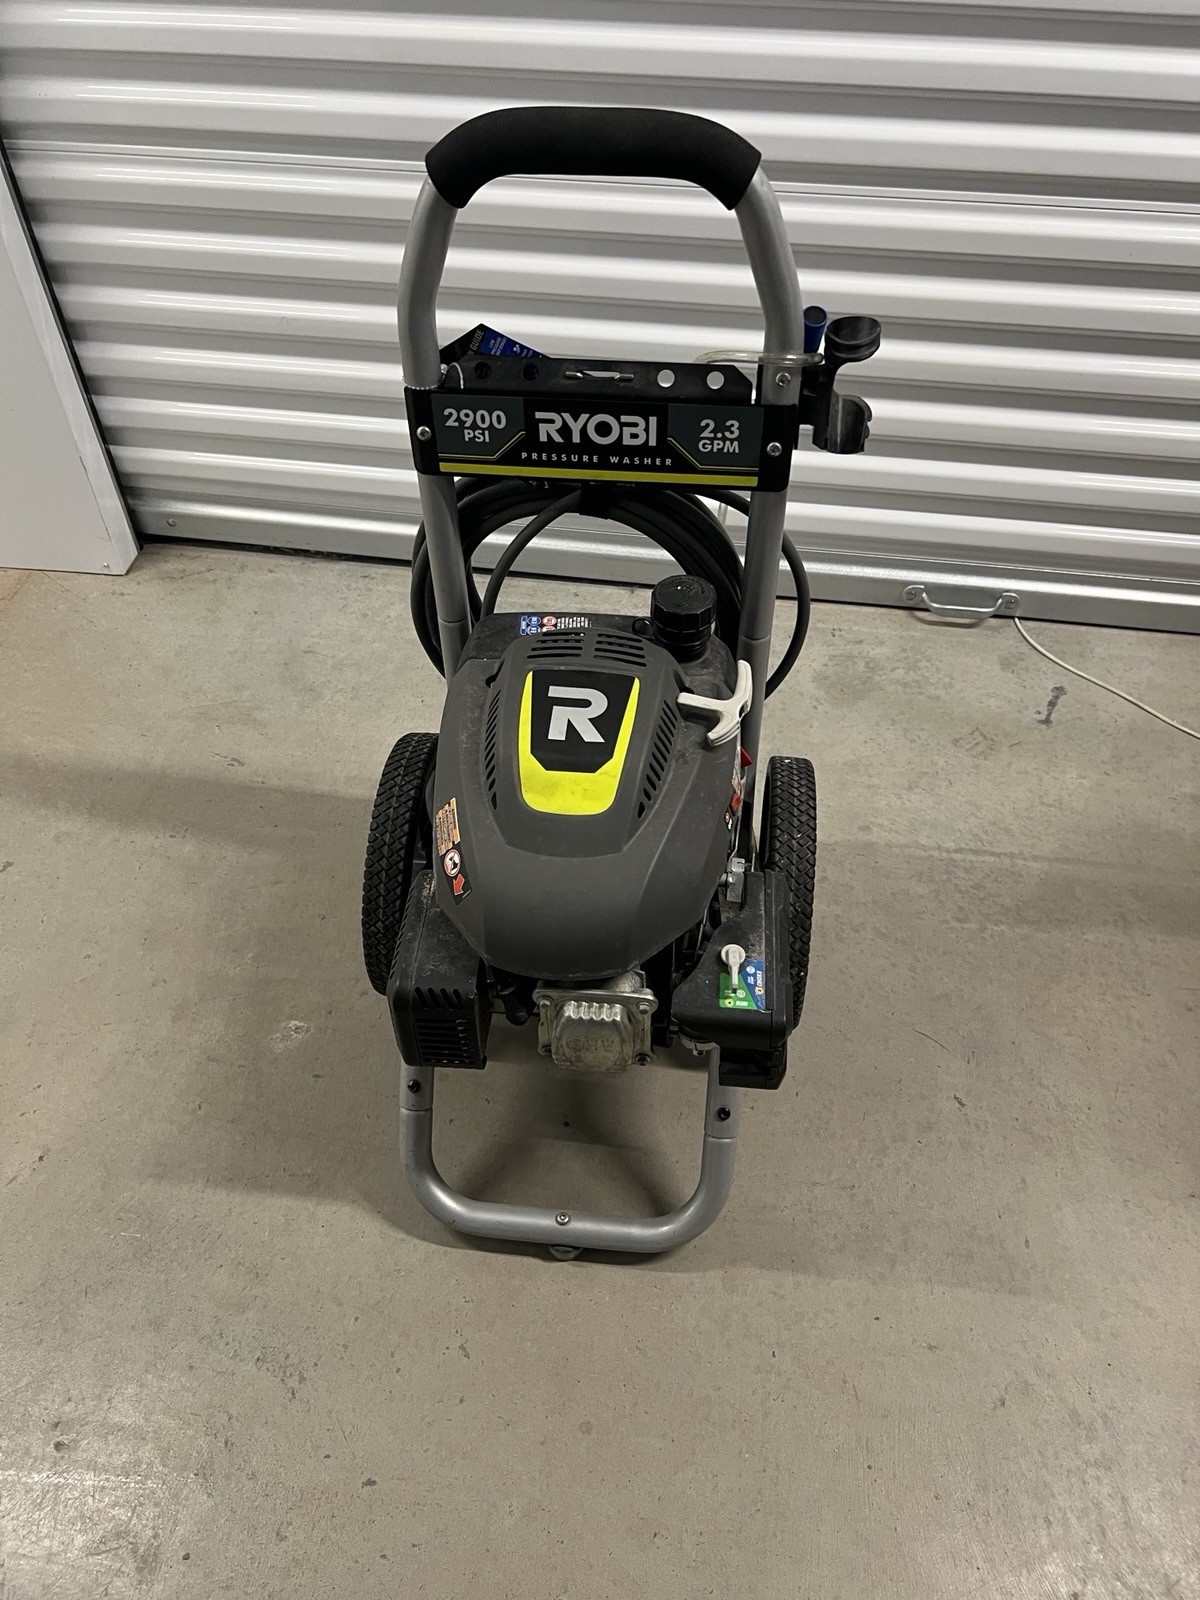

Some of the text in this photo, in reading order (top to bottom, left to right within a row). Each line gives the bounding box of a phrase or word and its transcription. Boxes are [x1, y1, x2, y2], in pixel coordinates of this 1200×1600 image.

[470, 329, 484, 351] GUIDE
[443, 408, 507, 429] 2900
[535, 411, 657, 446] RYOBI
[464, 429, 490, 443] PSI
[699, 419, 740, 439] 2.3
[698, 439, 739, 453] GPM
[521, 452, 672, 466] PRESSURE WASHER
[547, 685, 608, 742] R
